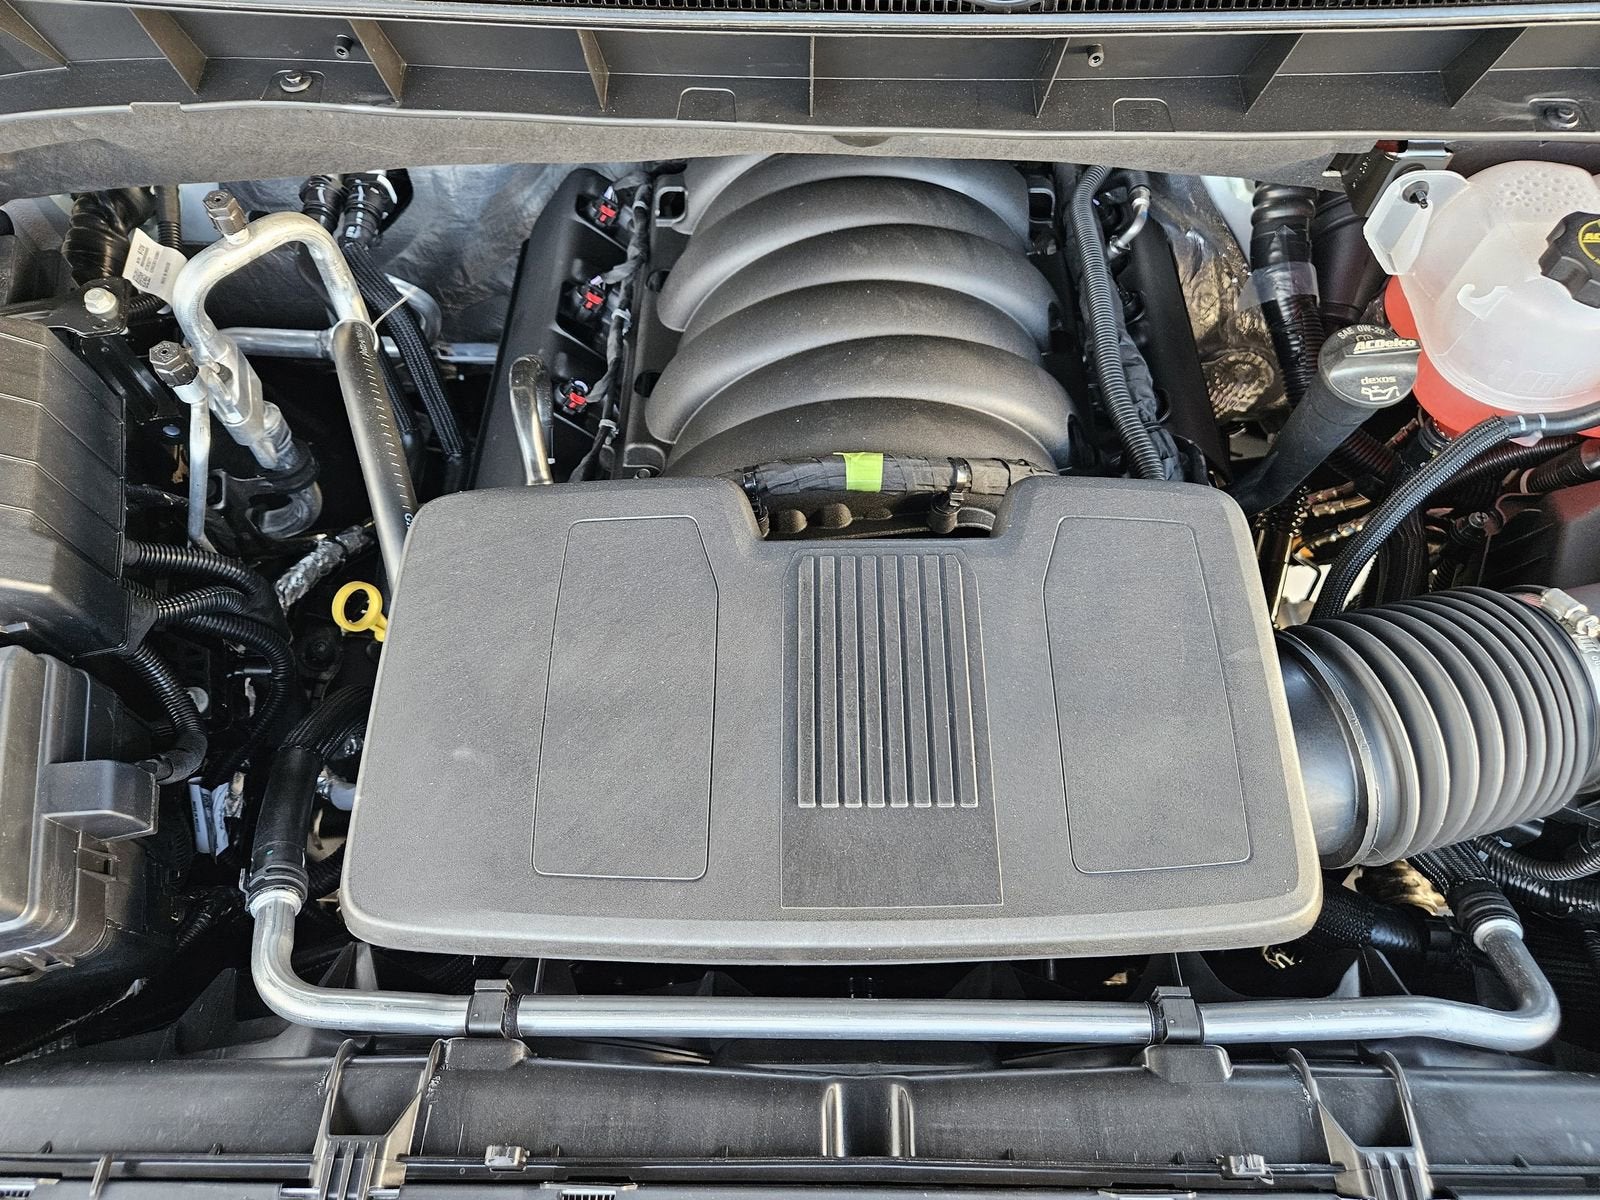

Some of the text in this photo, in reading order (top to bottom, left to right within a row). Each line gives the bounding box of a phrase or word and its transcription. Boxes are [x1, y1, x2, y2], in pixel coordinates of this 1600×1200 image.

[1337, 324, 1386, 340] SAE 0W-20
[1353, 338, 1417, 352] ACDelco
[1360, 376, 1397, 385] dexos
